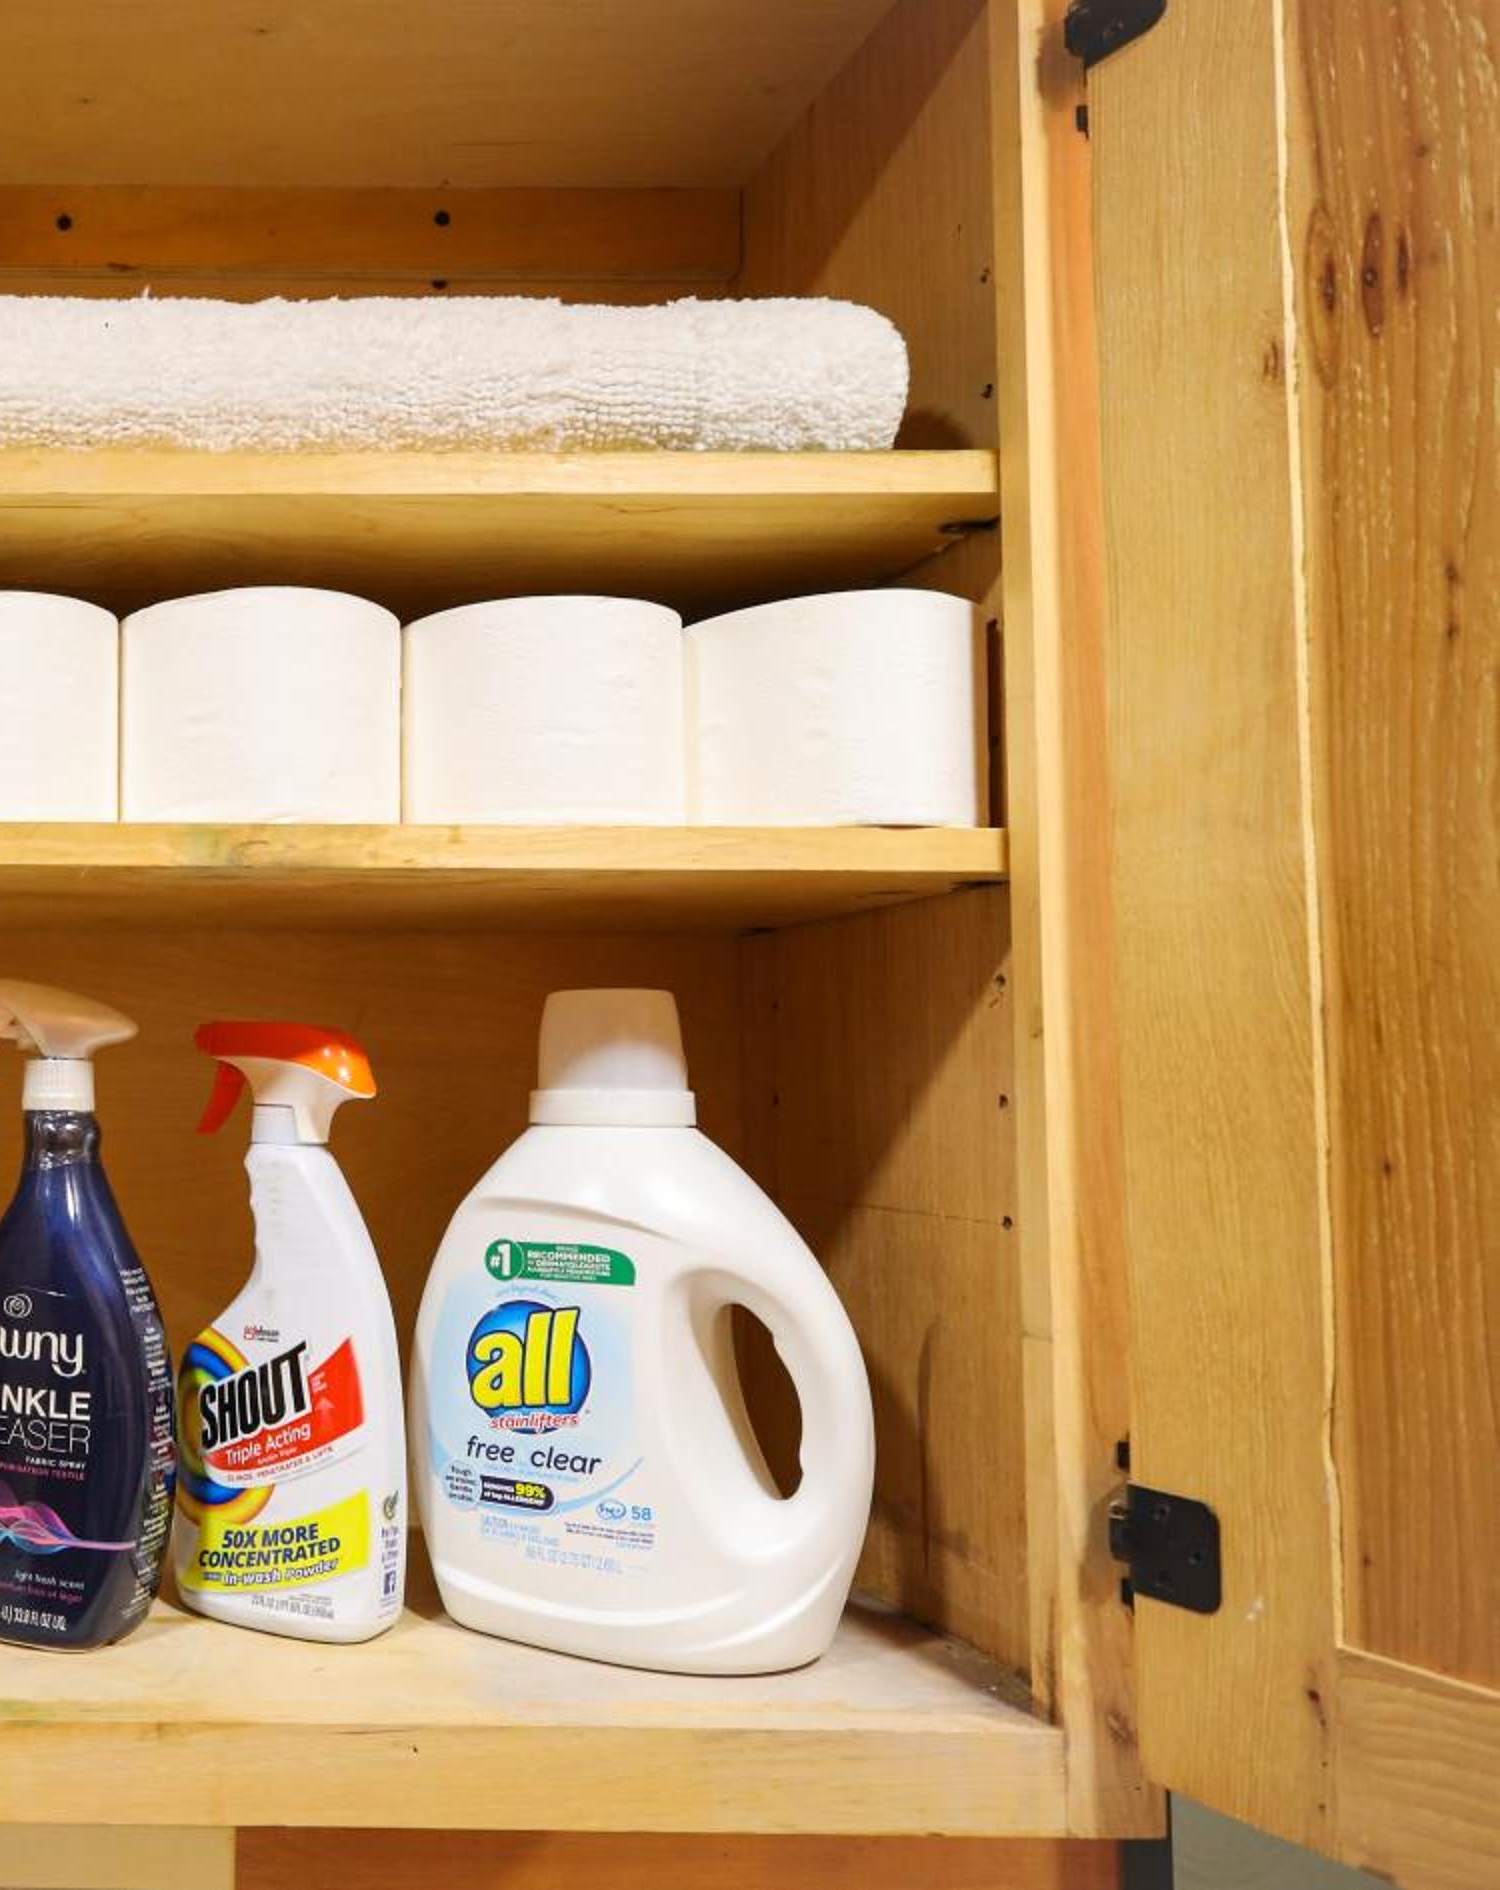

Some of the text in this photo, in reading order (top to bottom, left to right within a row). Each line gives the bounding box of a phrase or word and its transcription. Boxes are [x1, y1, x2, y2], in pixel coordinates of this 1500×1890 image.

[490, 1243, 511, 1276] #1
[471, 1308, 580, 1408] all
[201, 1341, 307, 1450] SHOUT
[490, 1412, 578, 1431] stainlifters
[226, 1424, 311, 1465] Triple Acting
[467, 1435, 515, 1463] free
[531, 1446, 603, 1474] clear
[515, 1483, 547, 1498] 99%
[631, 1506, 653, 1521] 58
[222, 1523, 319, 1549] 50X MORE
[199, 1537, 341, 1568] CONCENTRATED
